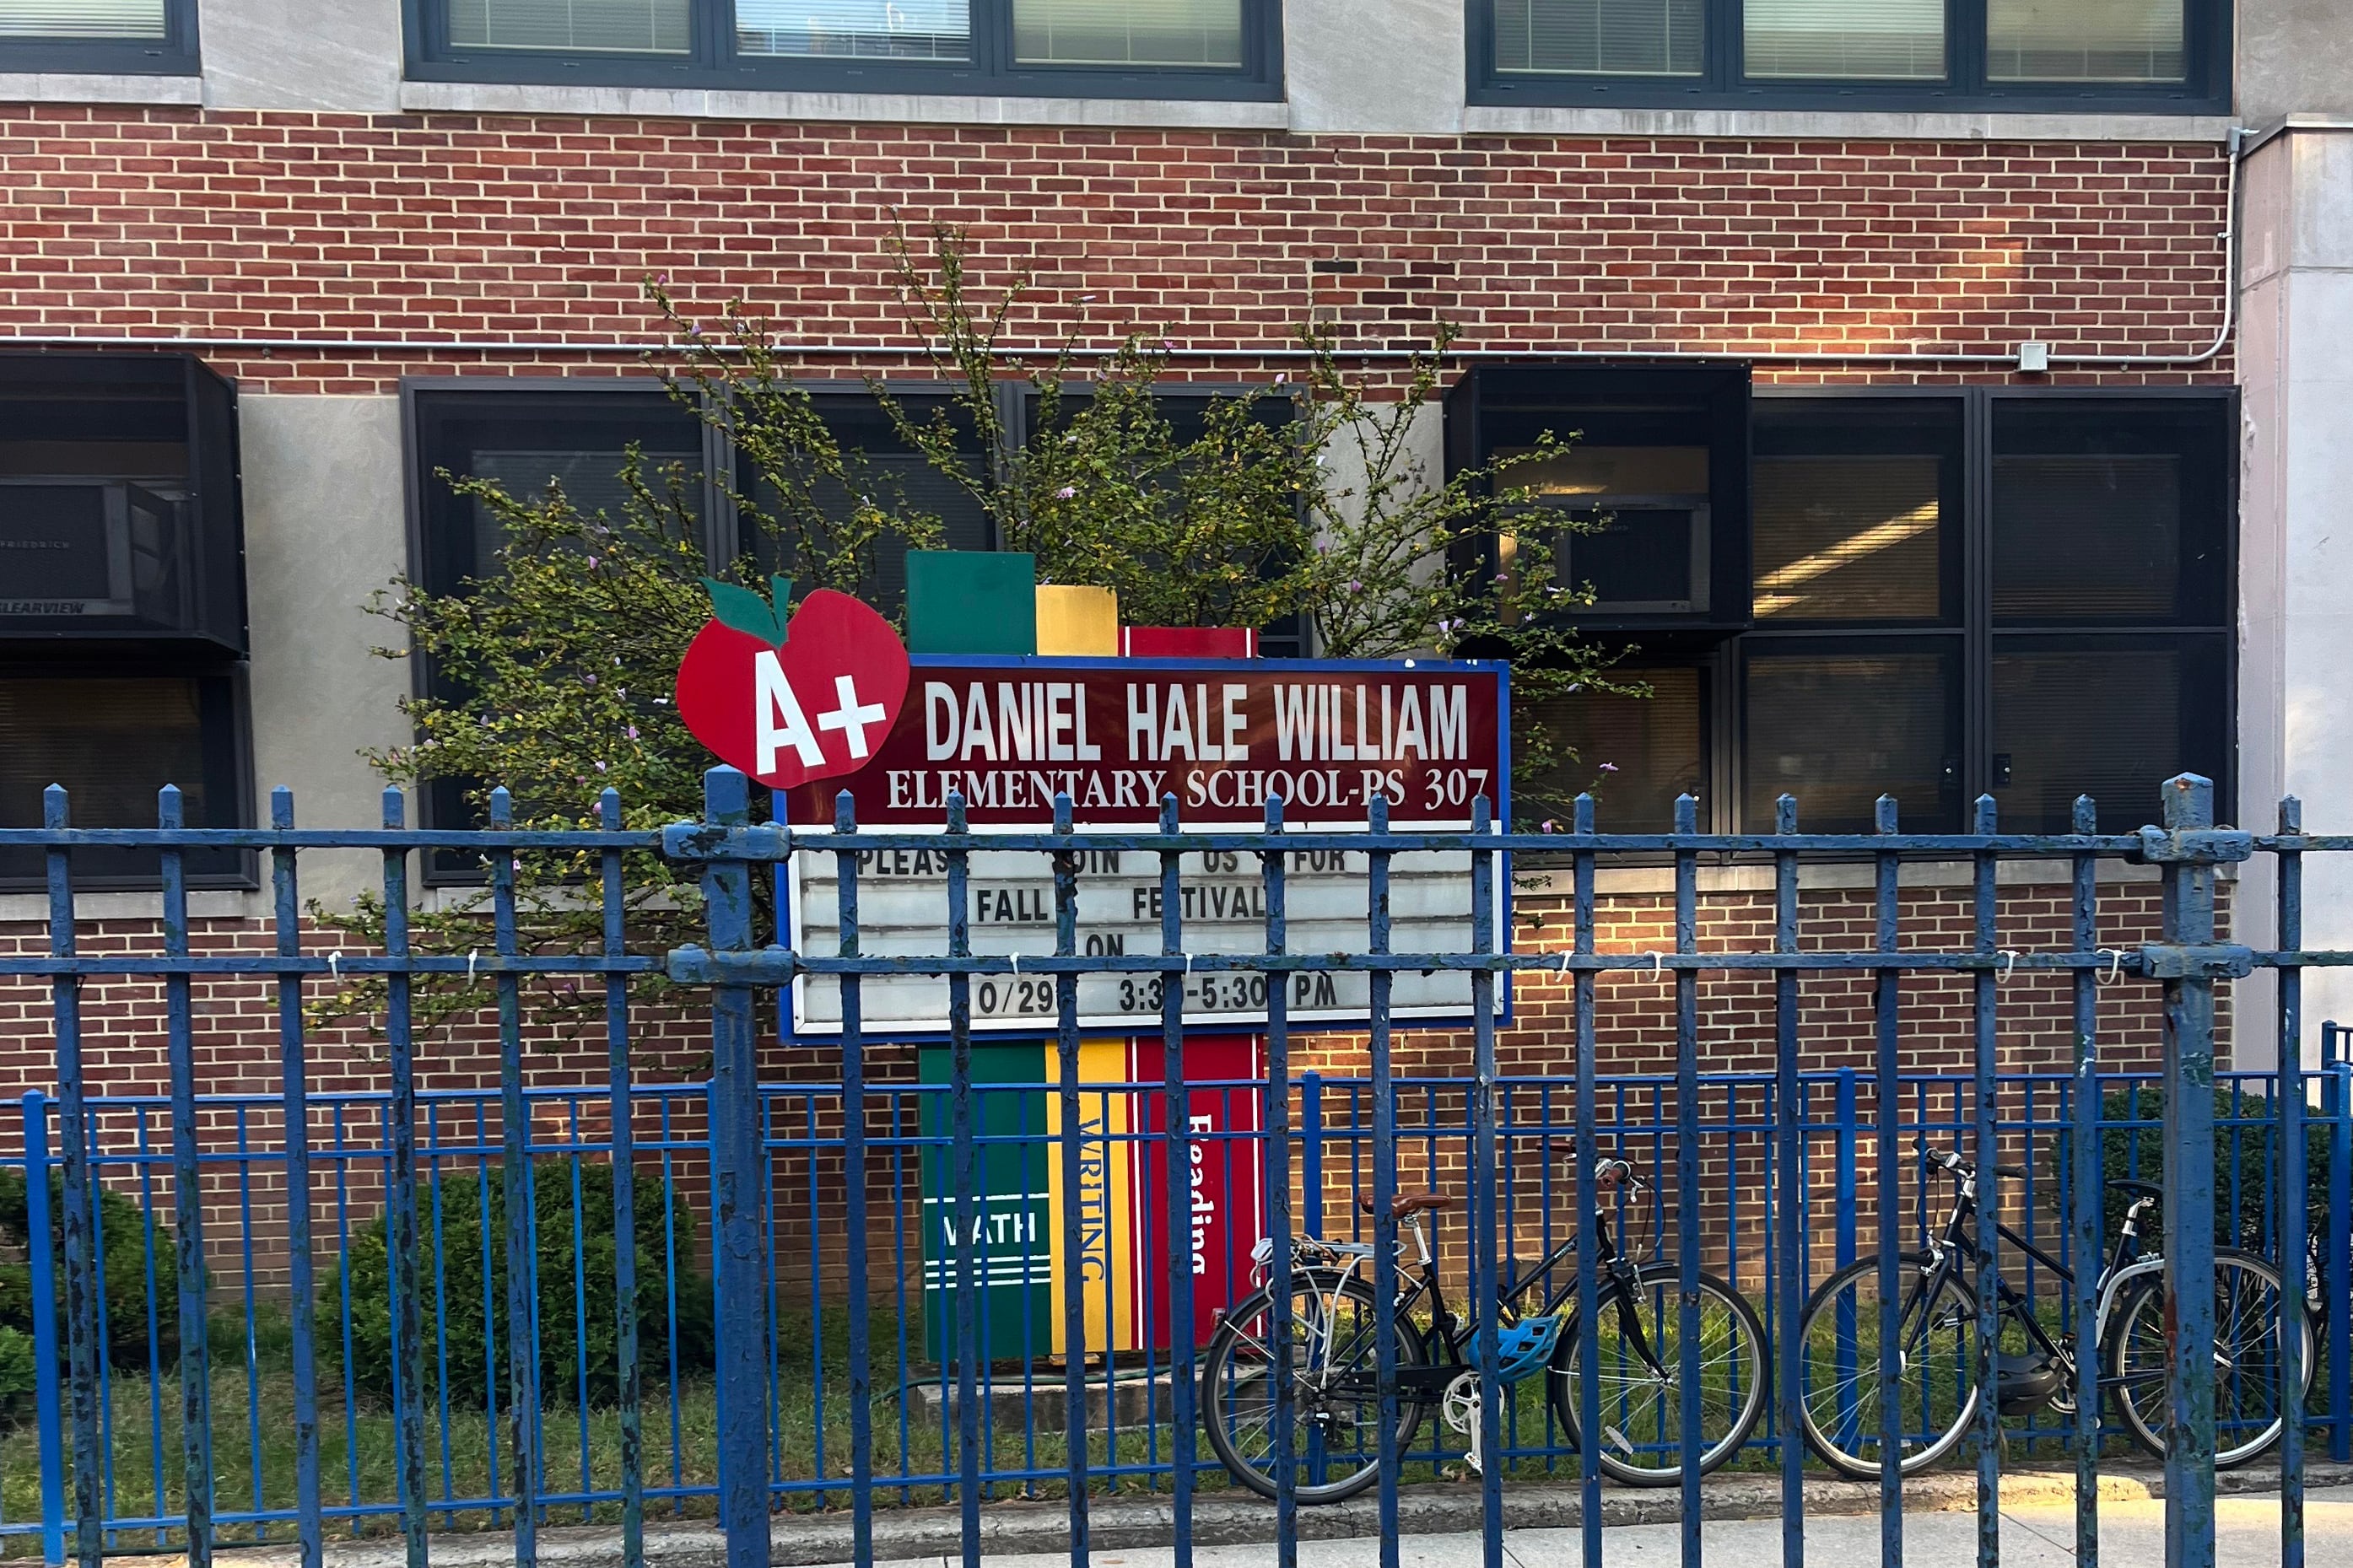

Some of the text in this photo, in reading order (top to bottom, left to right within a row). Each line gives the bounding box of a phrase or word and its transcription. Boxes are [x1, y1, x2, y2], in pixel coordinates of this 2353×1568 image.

[0, 601, 85, 615] LEARVIEW
[755, 650, 887, 775] A+
[925, 682, 1467, 761] DANIEL HALE WILLIAM
[886, 768, 1489, 811] ELEMENTARY SCHOOL-PS 307
[857, 850, 969, 875] PLEAS
[1204, 850, 1238, 872] US
[1294, 849, 1345, 871] FOR
[977, 886, 1266, 922] FALL FETIVAL
[1086, 934, 1124, 956] ON
[1120, 975, 1266, 1011] 3:3-5:30
[1295, 975, 1337, 1006] PM
